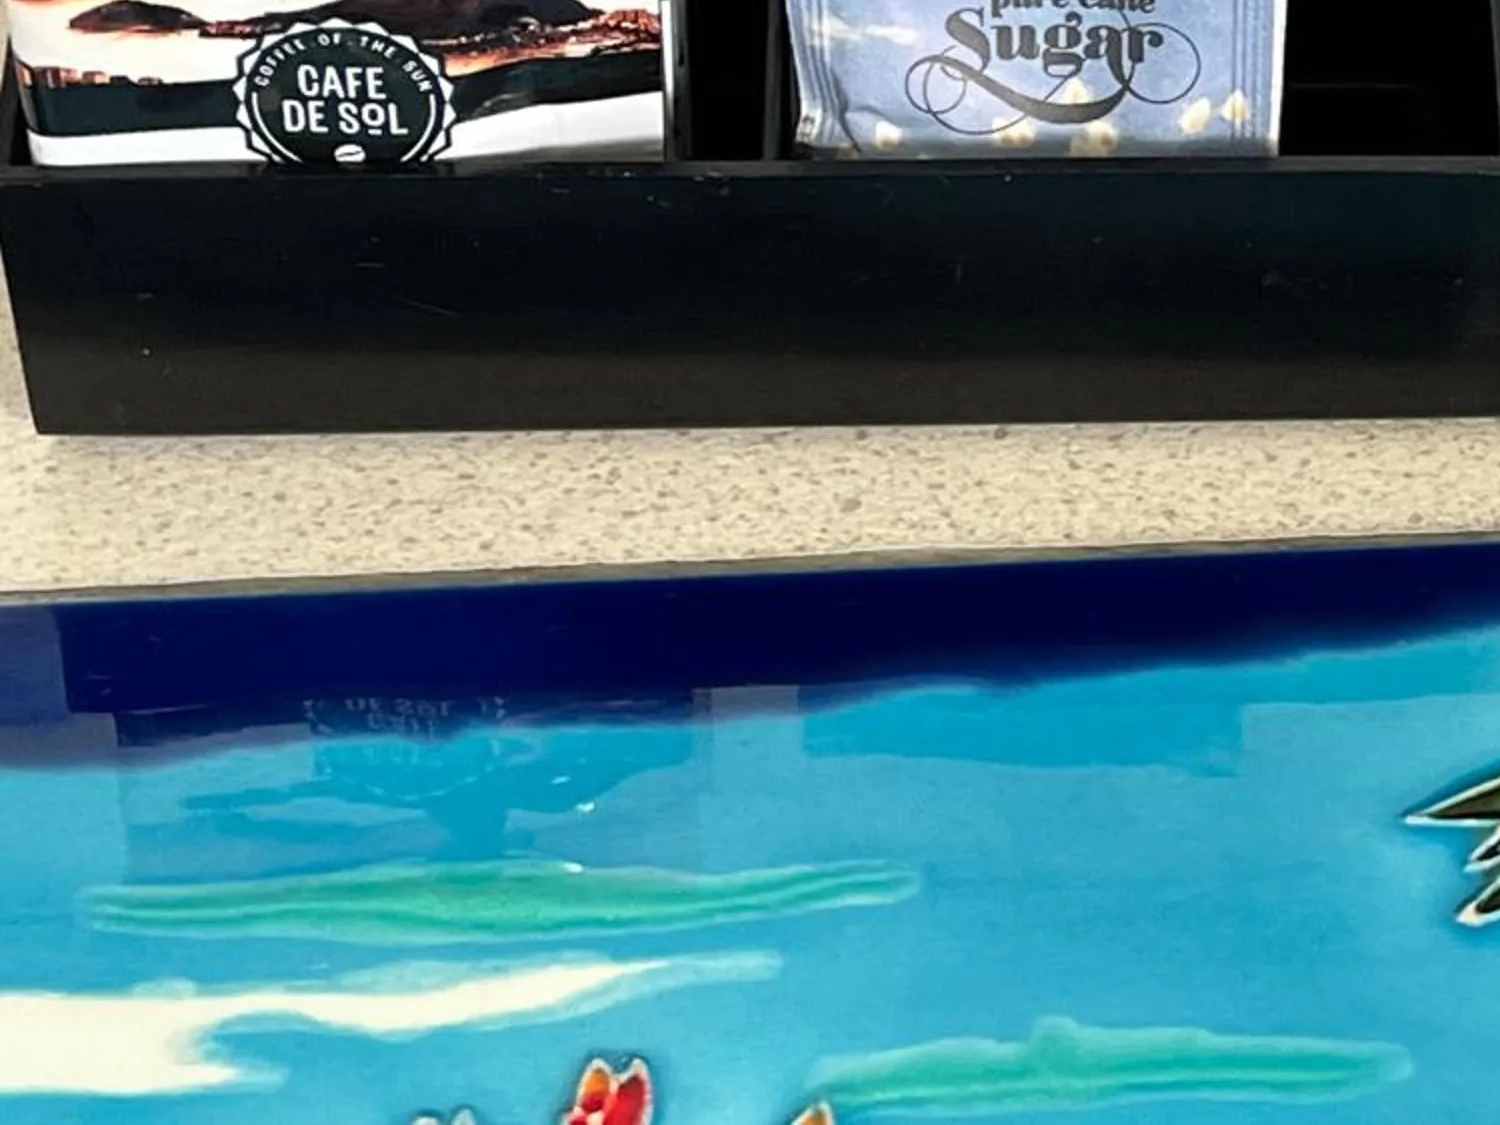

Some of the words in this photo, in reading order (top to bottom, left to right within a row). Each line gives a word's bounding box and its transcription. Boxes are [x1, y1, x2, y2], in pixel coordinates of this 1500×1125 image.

[253, 39, 306, 87] COFFEE
[317, 32, 342, 47] OF
[360, 35, 397, 59] THE
[402, 60, 433, 92] SUN
[297, 65, 387, 100] CAFE
[282, 100, 329, 133] DE
[338, 102, 409, 136] SOL
